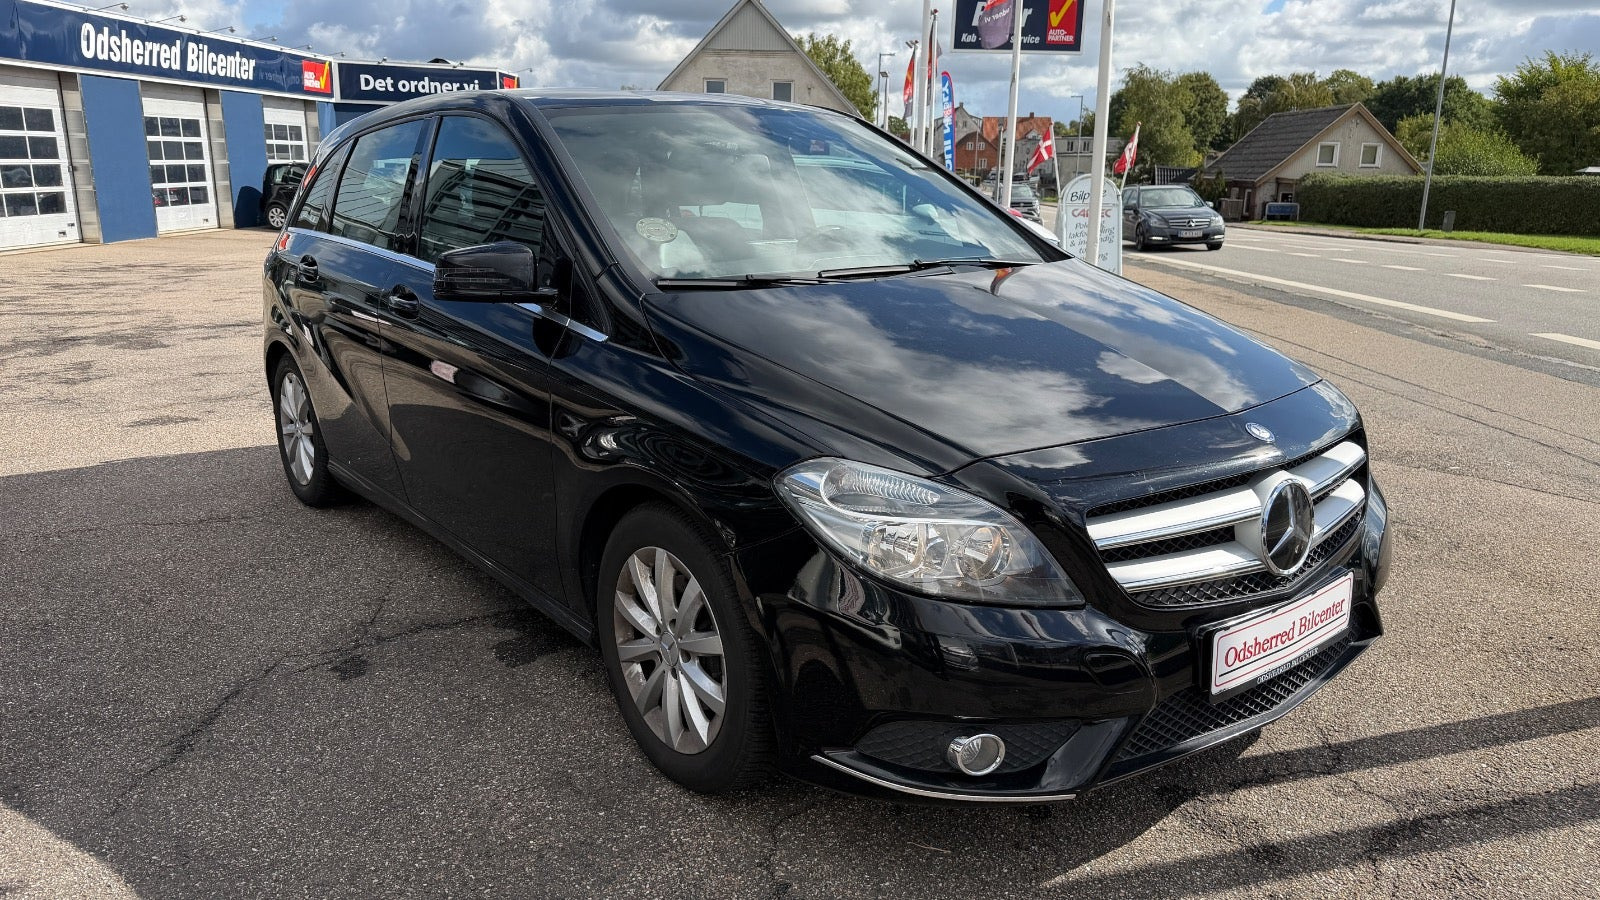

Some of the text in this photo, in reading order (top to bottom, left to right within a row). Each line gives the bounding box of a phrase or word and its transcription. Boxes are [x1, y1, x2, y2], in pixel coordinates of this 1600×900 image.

[81, 22, 256, 80] Odsherred Bilcenter
[961, 33, 1040, 43] Køb srvice
[360, 74, 394, 92] Det
[398, 77, 459, 94] ordner
[1224, 598, 1345, 668] Odsherred Bilcenter
